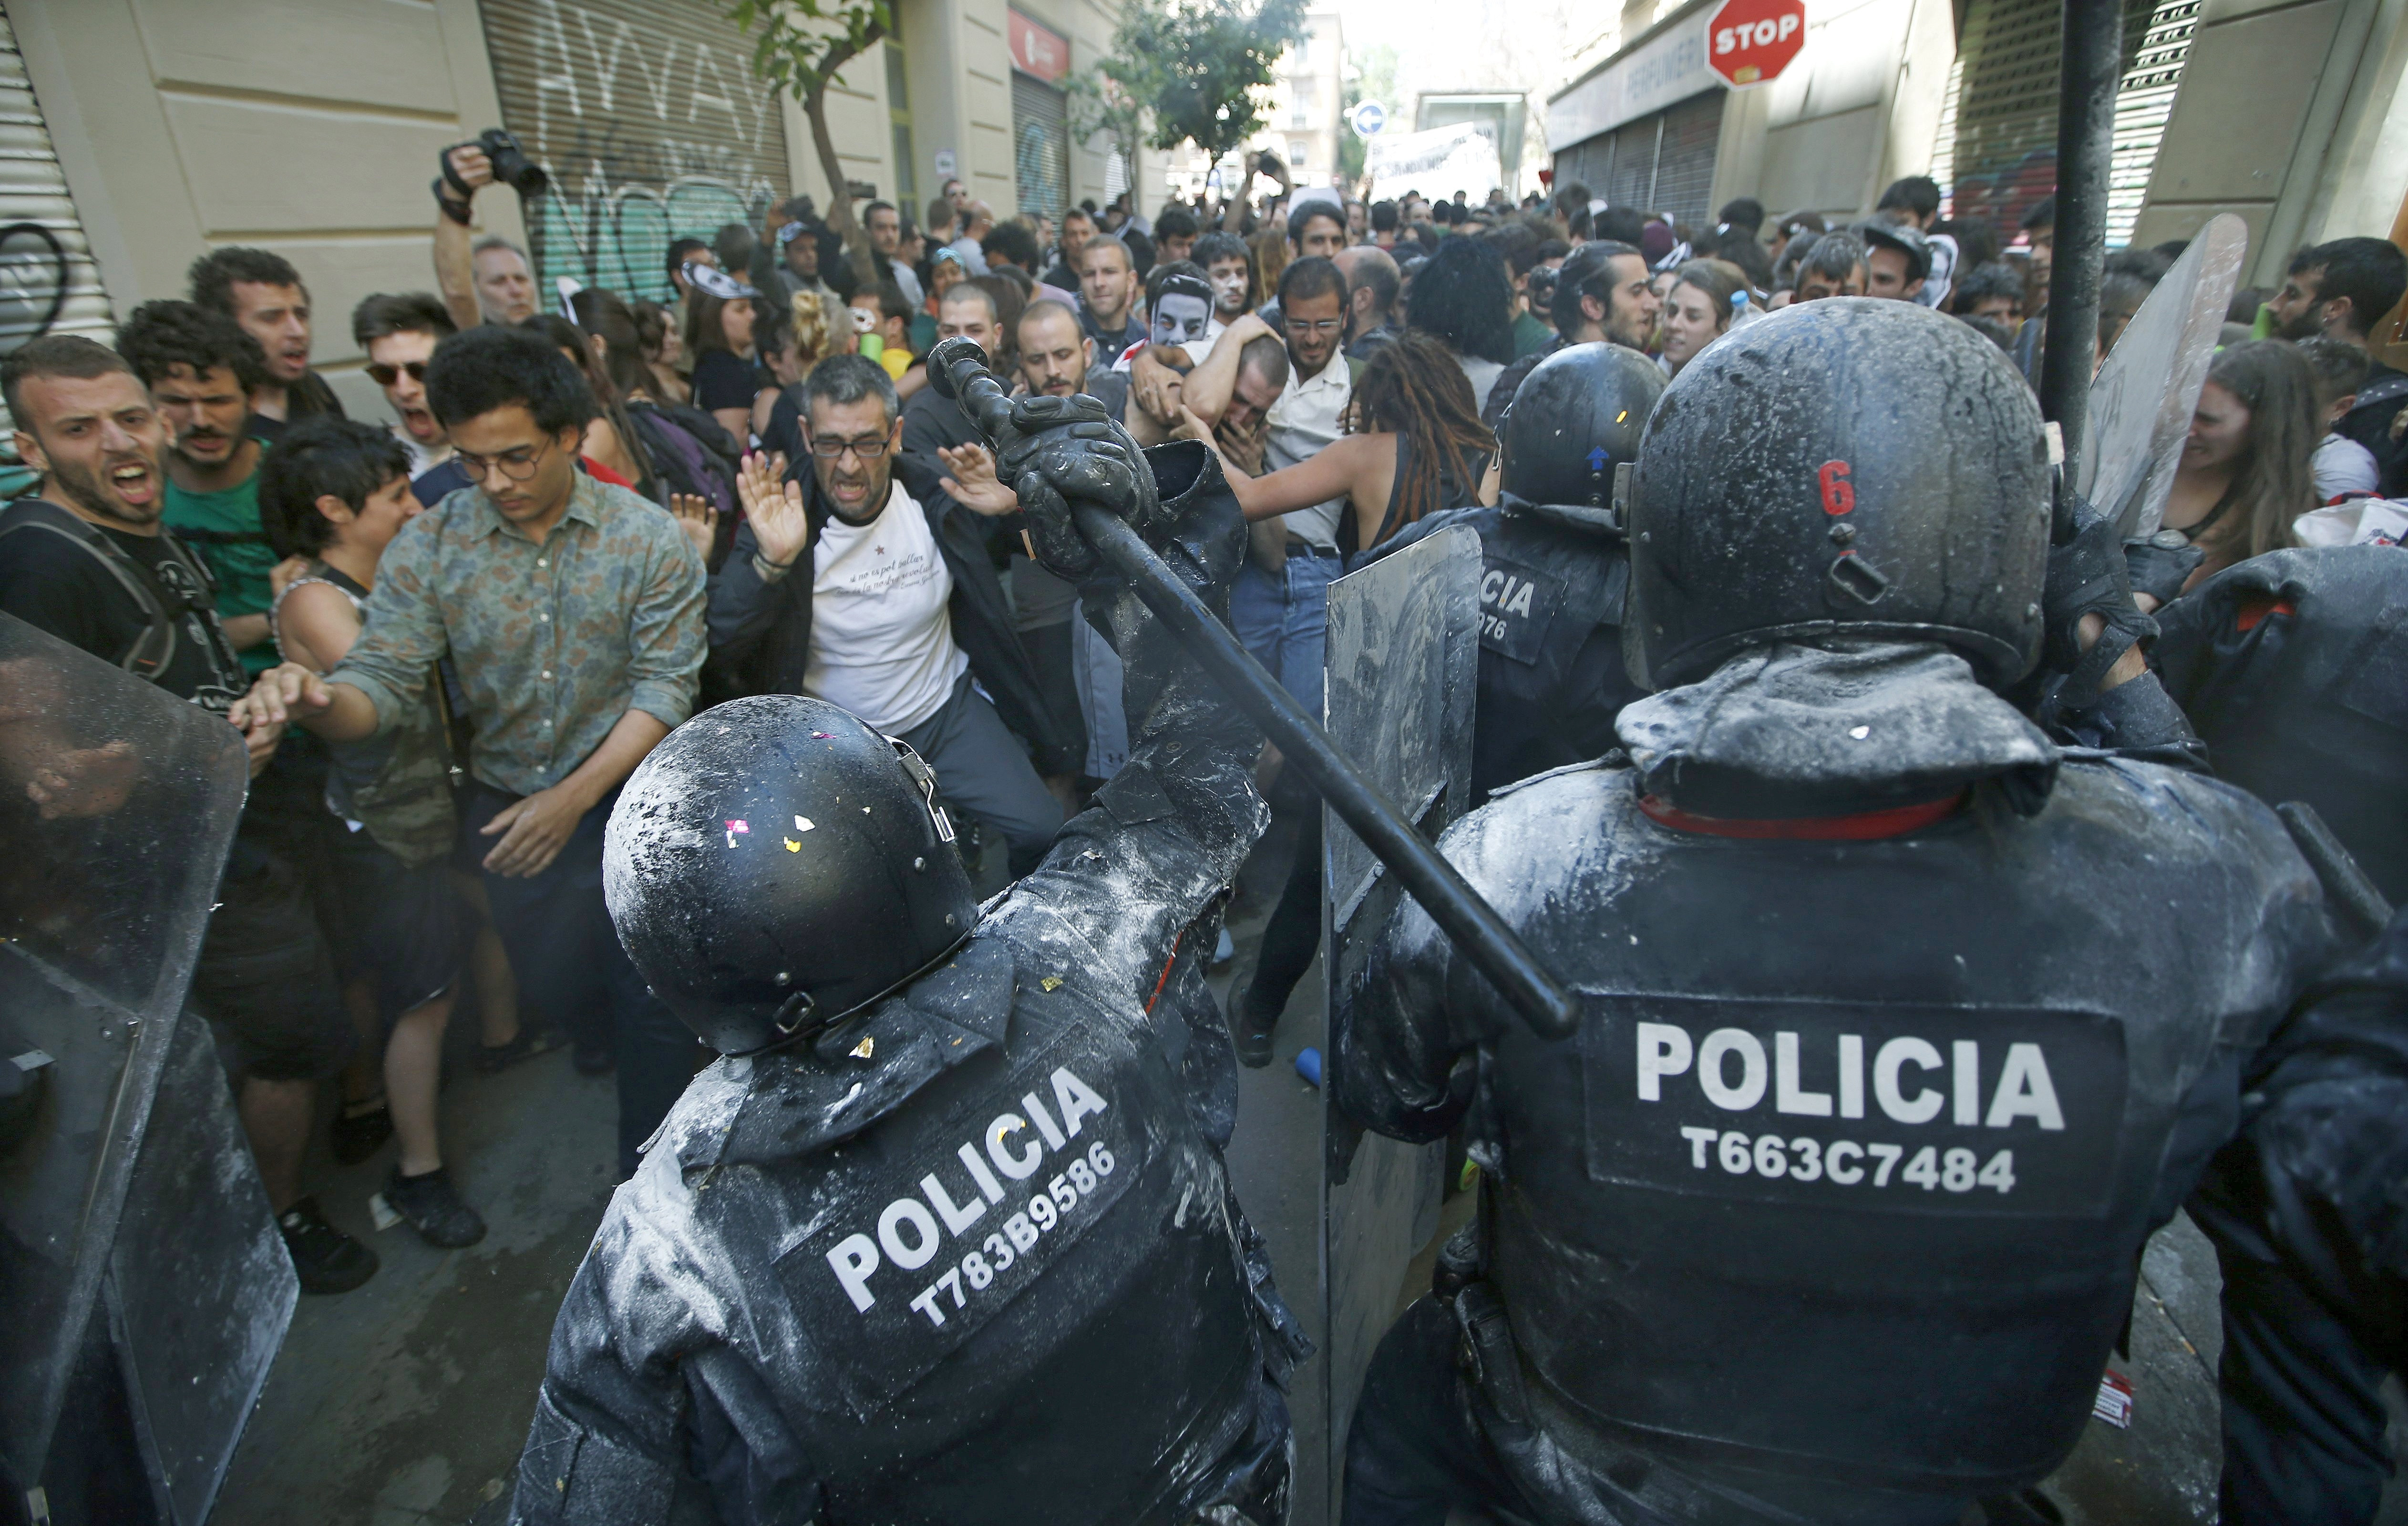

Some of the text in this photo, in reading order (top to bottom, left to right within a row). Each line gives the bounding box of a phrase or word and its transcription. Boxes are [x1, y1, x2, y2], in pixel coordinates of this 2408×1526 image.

[1715, 13, 1800, 55] STOP
[1818, 459, 1856, 515] 6
[858, 572, 868, 581] no
[879, 559, 896, 578] pot
[862, 581, 871, 592] la
[1480, 565, 1534, 619] CIA
[1637, 1022, 2065, 1131] POLICIA
[1680, 1126, 2016, 1194] T663C7484
[825, 1066, 1108, 1314] POLICIA
[909, 1141, 1115, 1327] T783B9586
